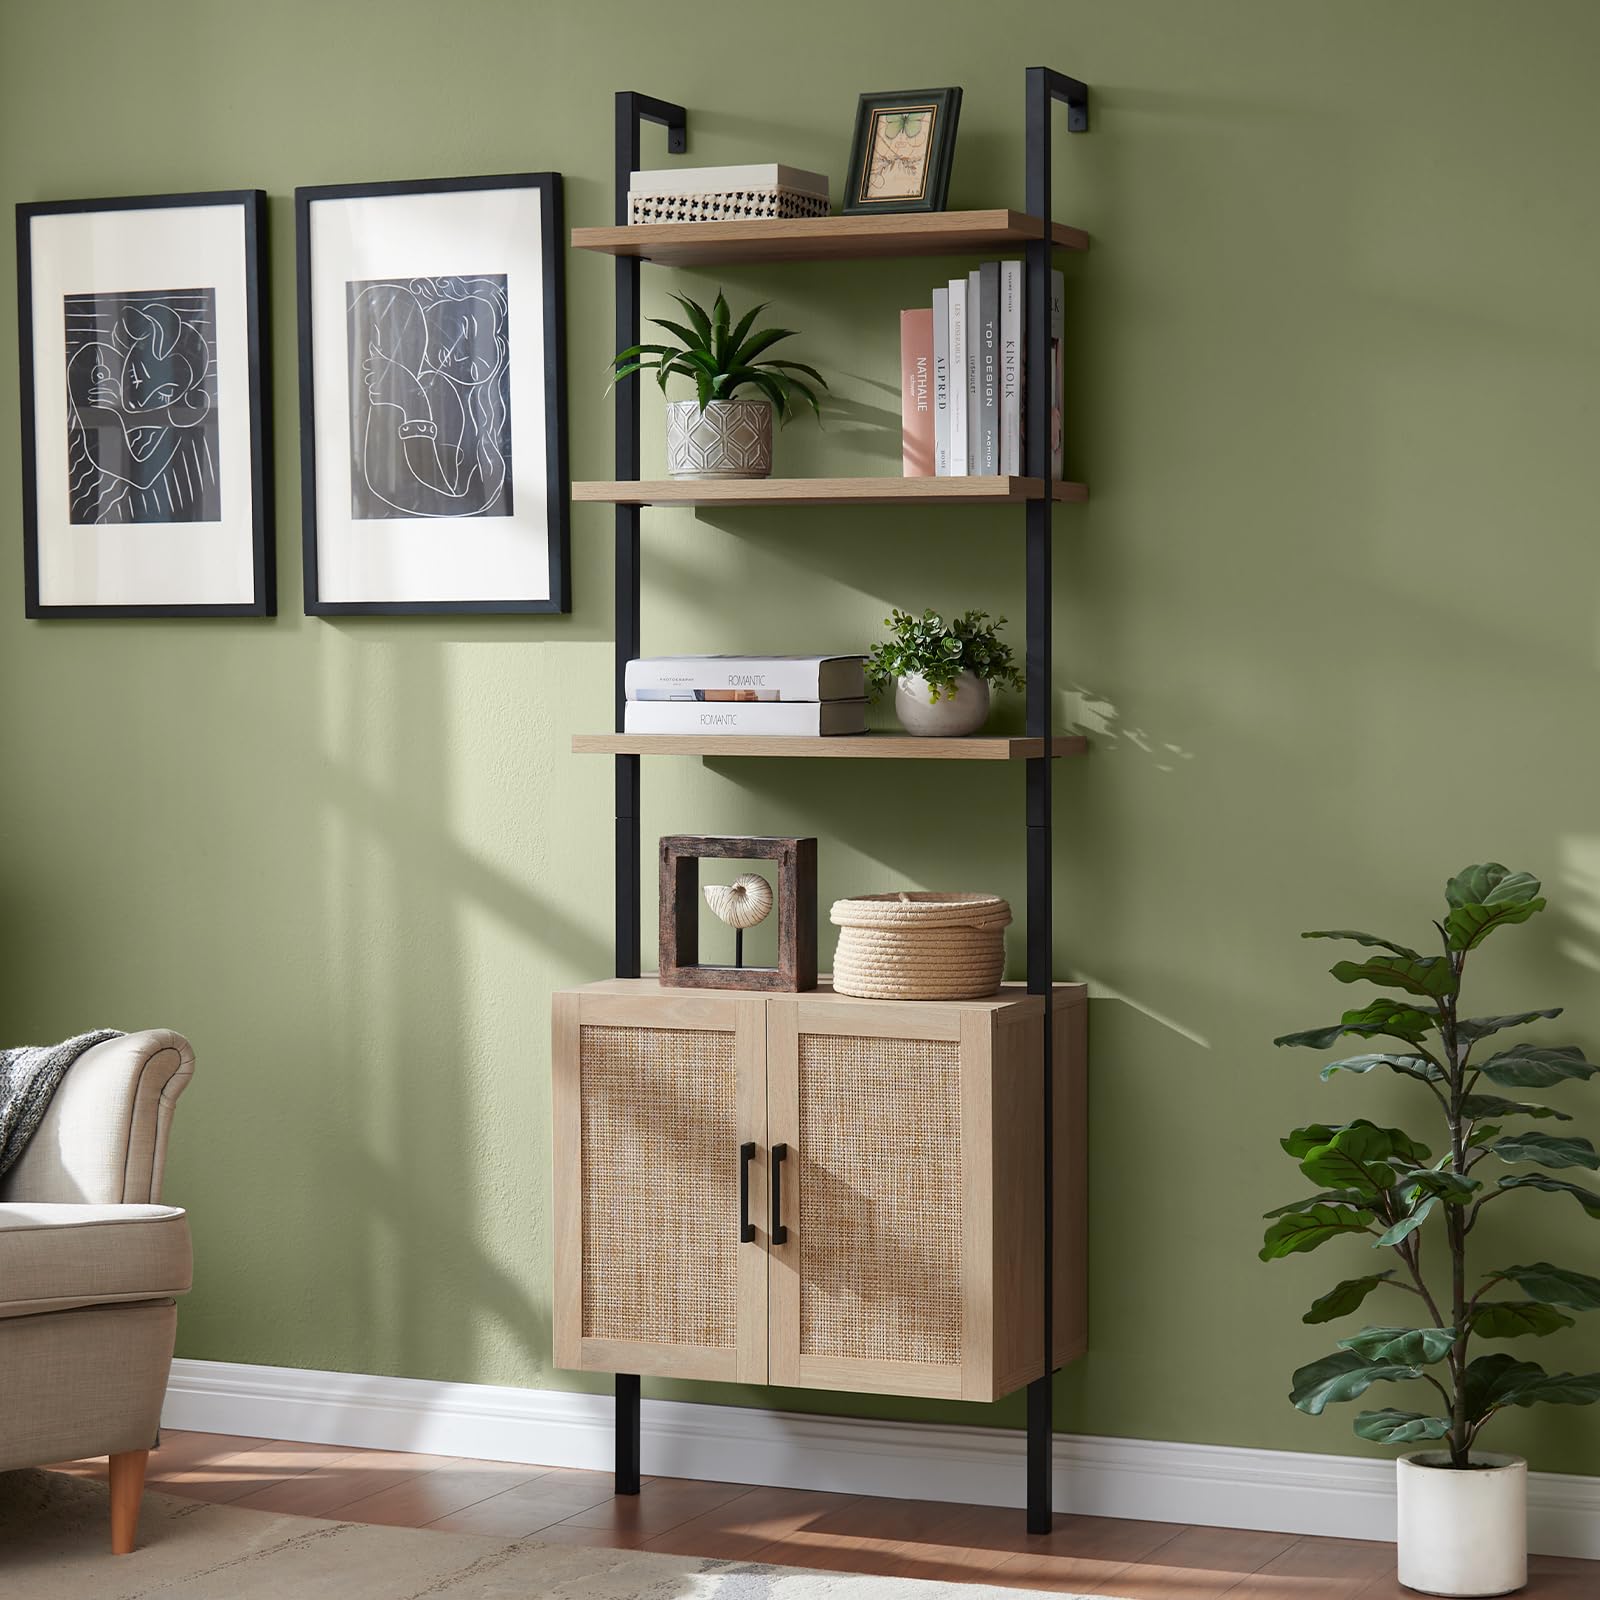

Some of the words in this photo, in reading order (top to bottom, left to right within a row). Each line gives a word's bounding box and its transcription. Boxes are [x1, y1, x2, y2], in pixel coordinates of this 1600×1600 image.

[985, 321, 993, 348] TOP
[916, 357, 928, 412] NATHALIE
[937, 356, 946, 410] ALPRED
[985, 355, 993, 407] DESIGN
[1005, 340, 1015, 398] KINFOLK
[728, 675, 766, 686] ROMANTIC
[700, 714, 737, 726] ROMANTIC
